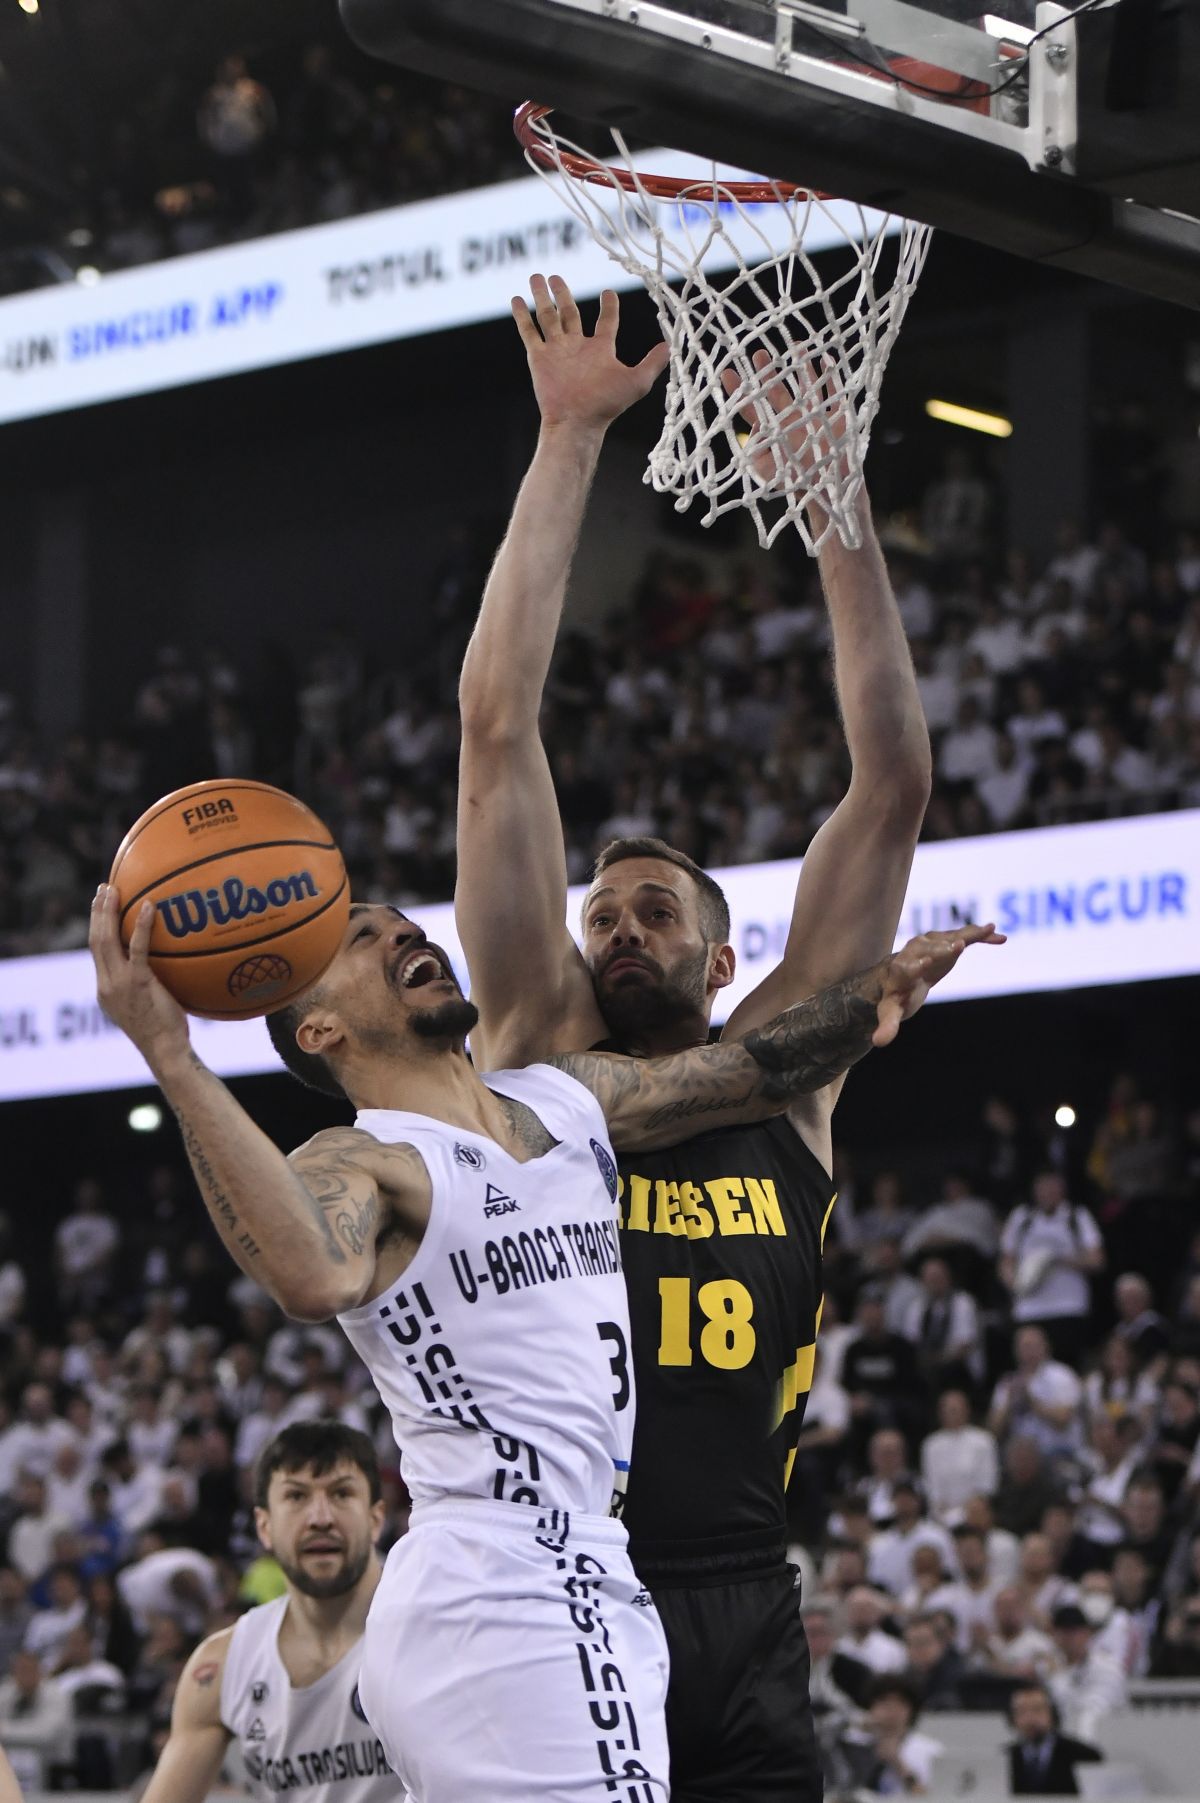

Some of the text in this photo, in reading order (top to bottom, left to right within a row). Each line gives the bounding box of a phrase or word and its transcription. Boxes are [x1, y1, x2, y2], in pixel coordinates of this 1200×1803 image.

[210, 281, 282, 332] APP
[325, 254, 447, 306] TOTUL
[182, 798, 235, 828] FIBA
[156, 869, 319, 939] Wilson
[1000, 872, 1188, 935] SINGUR
[483, 1199, 522, 1220] PEAK
[448, 1225, 572, 1305] U-BANCA
[657, 1276, 757, 1371] 18
[596, 1321, 631, 1413] 3
